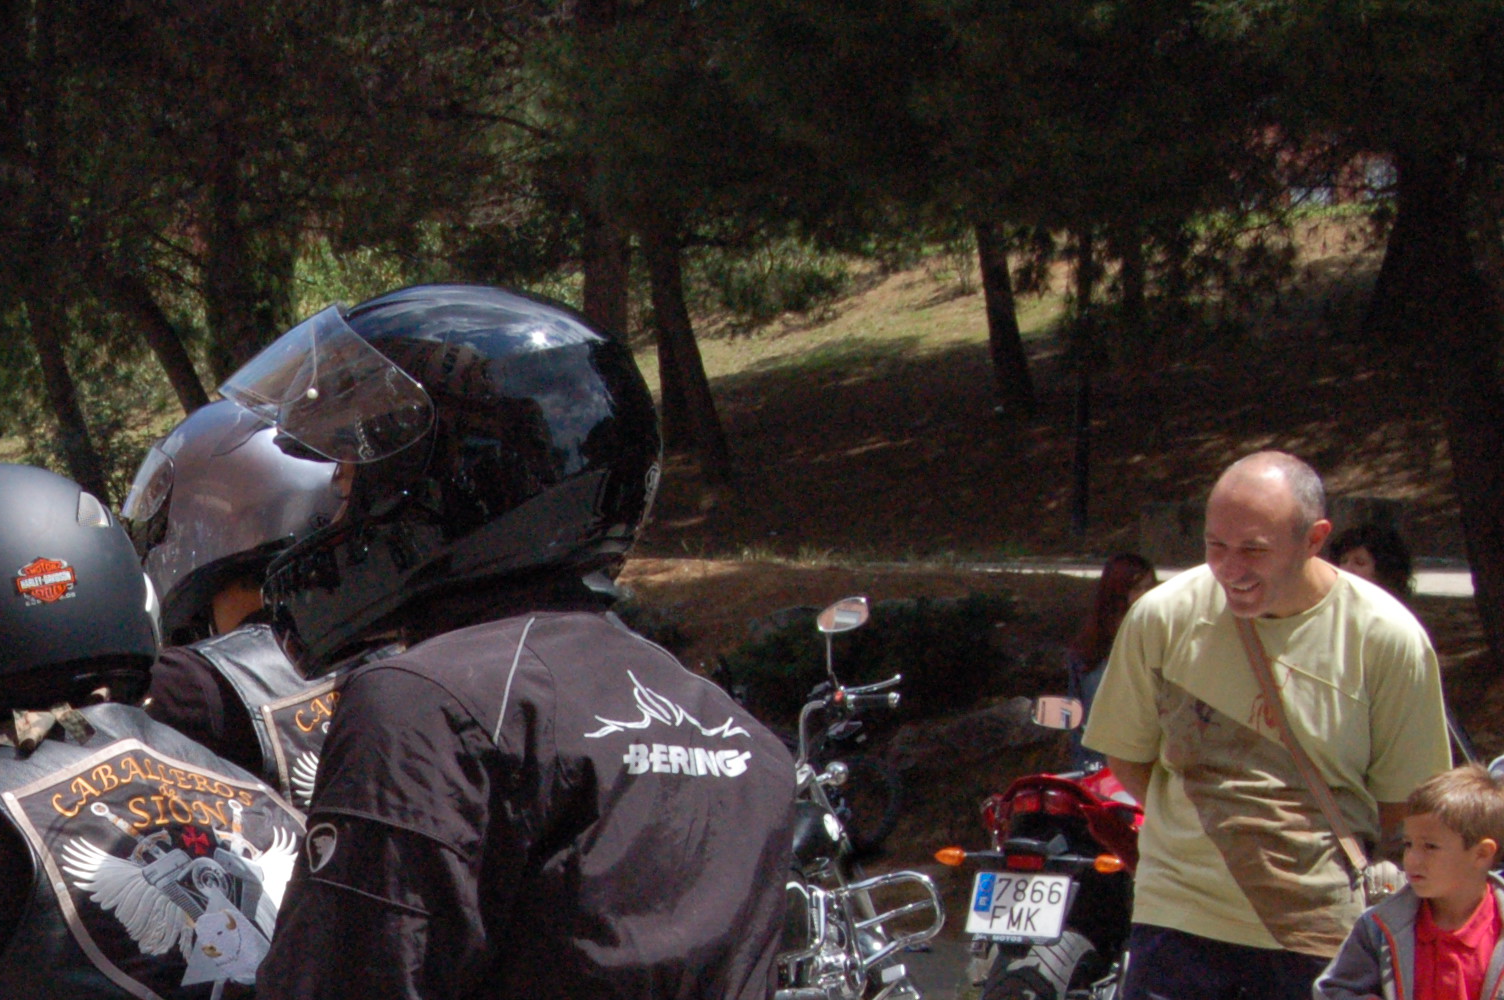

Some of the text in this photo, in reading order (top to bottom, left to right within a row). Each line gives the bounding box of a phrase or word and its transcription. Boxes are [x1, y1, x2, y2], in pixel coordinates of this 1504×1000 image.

[623, 743, 752, 778] BERING
[52, 757, 253, 817] CABALLEROS
[128, 795, 229, 828] SION
[995, 878, 1063, 904] 7866
[989, 905, 1041, 932] FMK
